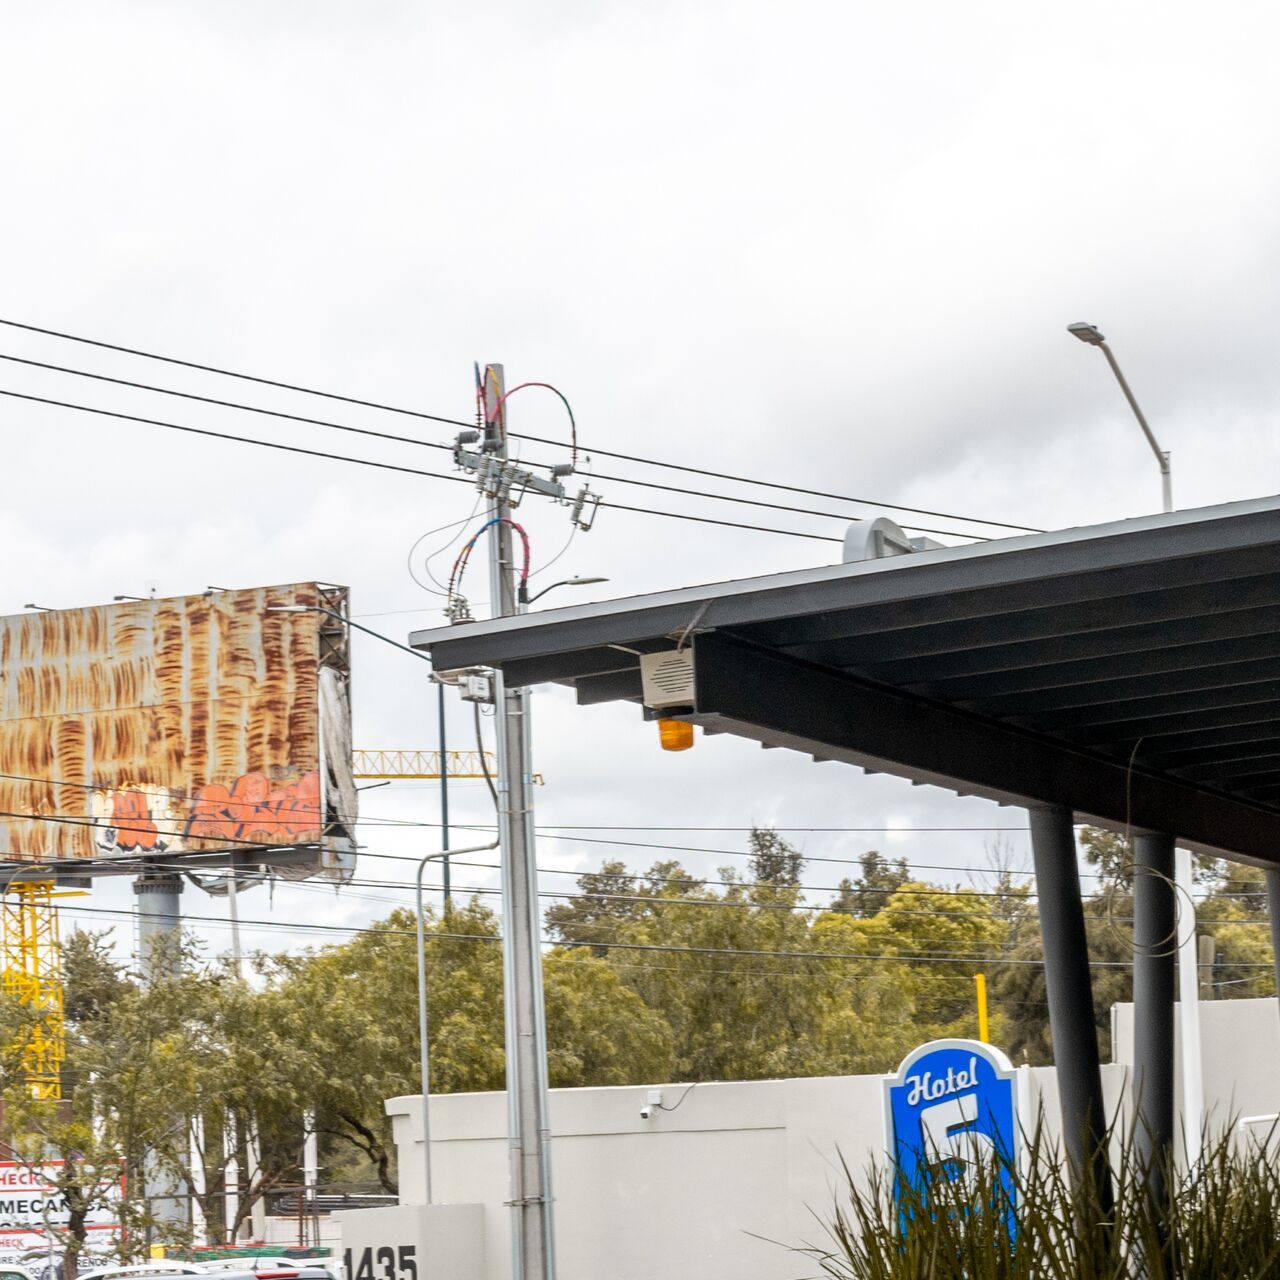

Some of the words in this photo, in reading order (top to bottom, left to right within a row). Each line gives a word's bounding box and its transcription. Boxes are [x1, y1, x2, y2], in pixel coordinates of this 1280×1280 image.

[906, 1057, 978, 1106] Hotel
[0, 1199, 109, 1214] MECANCA
[77, 1257, 108, 1267] RENOS
